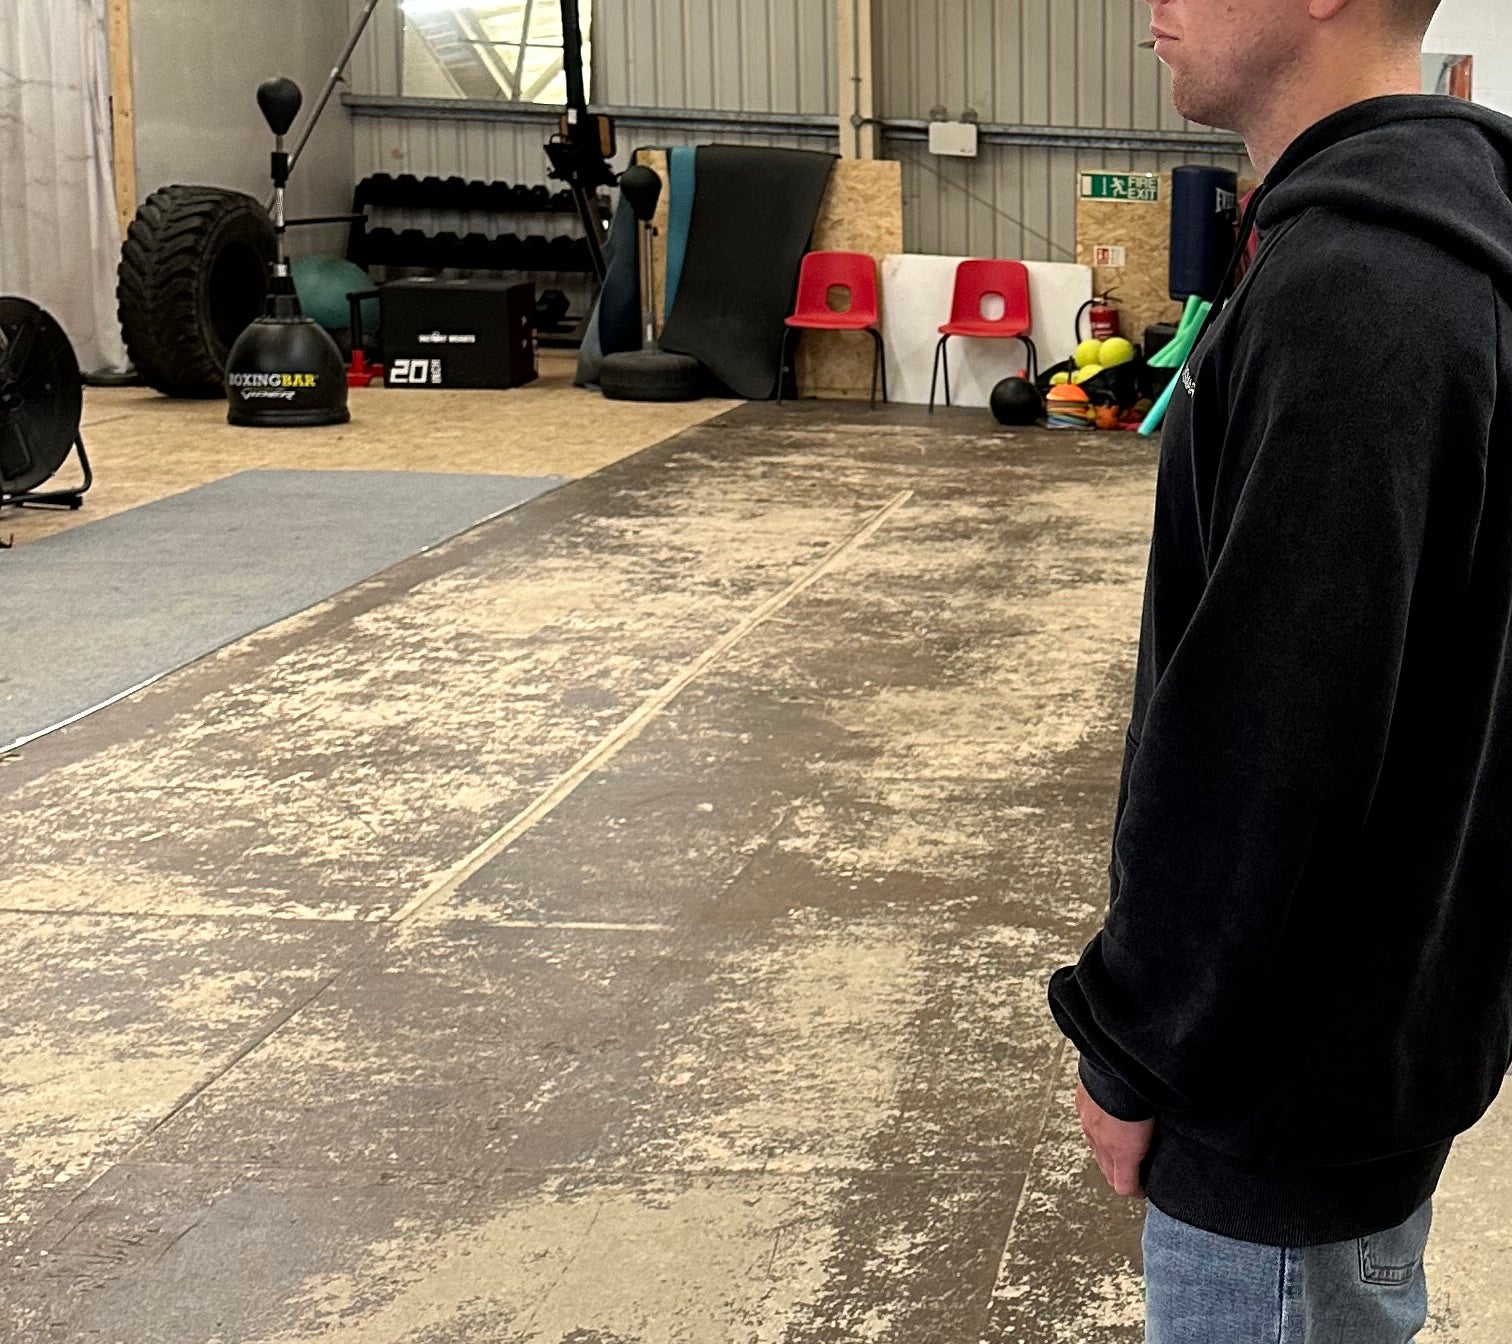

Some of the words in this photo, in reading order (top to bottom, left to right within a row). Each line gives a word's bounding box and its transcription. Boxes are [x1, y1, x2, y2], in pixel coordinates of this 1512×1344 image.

[1128, 177, 1157, 188] FIRE
[1128, 189, 1157, 200] EXIT
[389, 359, 429, 383] 20
